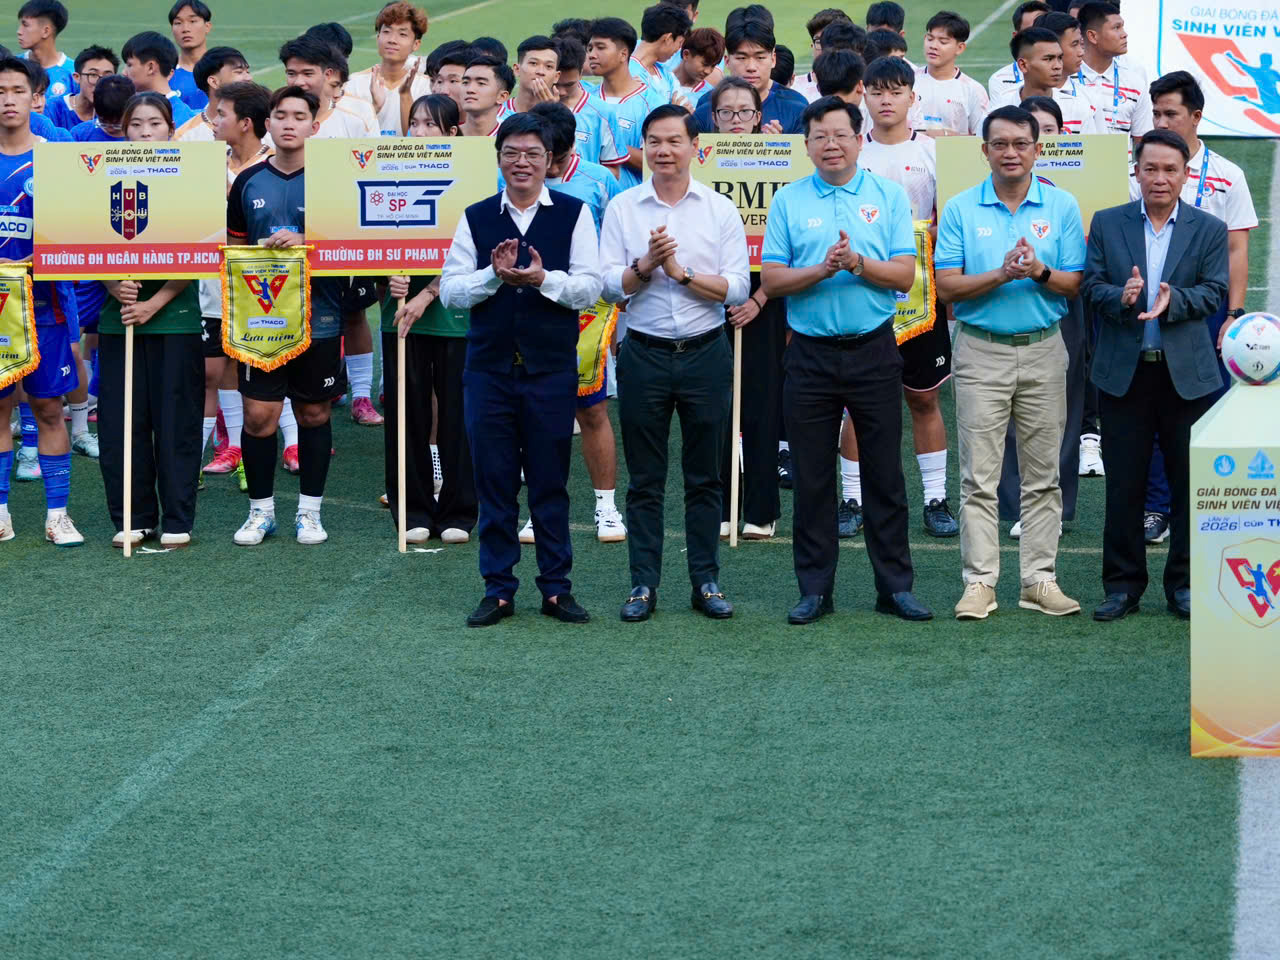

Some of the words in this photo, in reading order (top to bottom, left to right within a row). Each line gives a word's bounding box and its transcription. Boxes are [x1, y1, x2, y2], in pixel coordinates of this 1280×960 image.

[1172, 18, 1217, 35] SINH
[1223, 21, 1267, 37] VIÊN
[112, 192, 146, 200] HUB
[389, 199, 407, 212] SP
[0, 221, 27, 233] ACO
[40, 249, 85, 265] TRƯỜNG
[88, 252, 103, 265] ĐH
[107, 249, 139, 265] NGÂN
[142, 249, 174, 264] HÀNG
[177, 251, 220, 264] TP.HCM
[318, 246, 364, 261] TRƯỜNG
[367, 249, 382, 261] ĐH
[386, 248, 402, 261] SƯ
[404, 248, 438, 263] PHẠM
[1196, 500, 1228, 510] SINH
[1231, 498, 1261, 510] VIÊN
[1200, 522, 1238, 531] 2026
